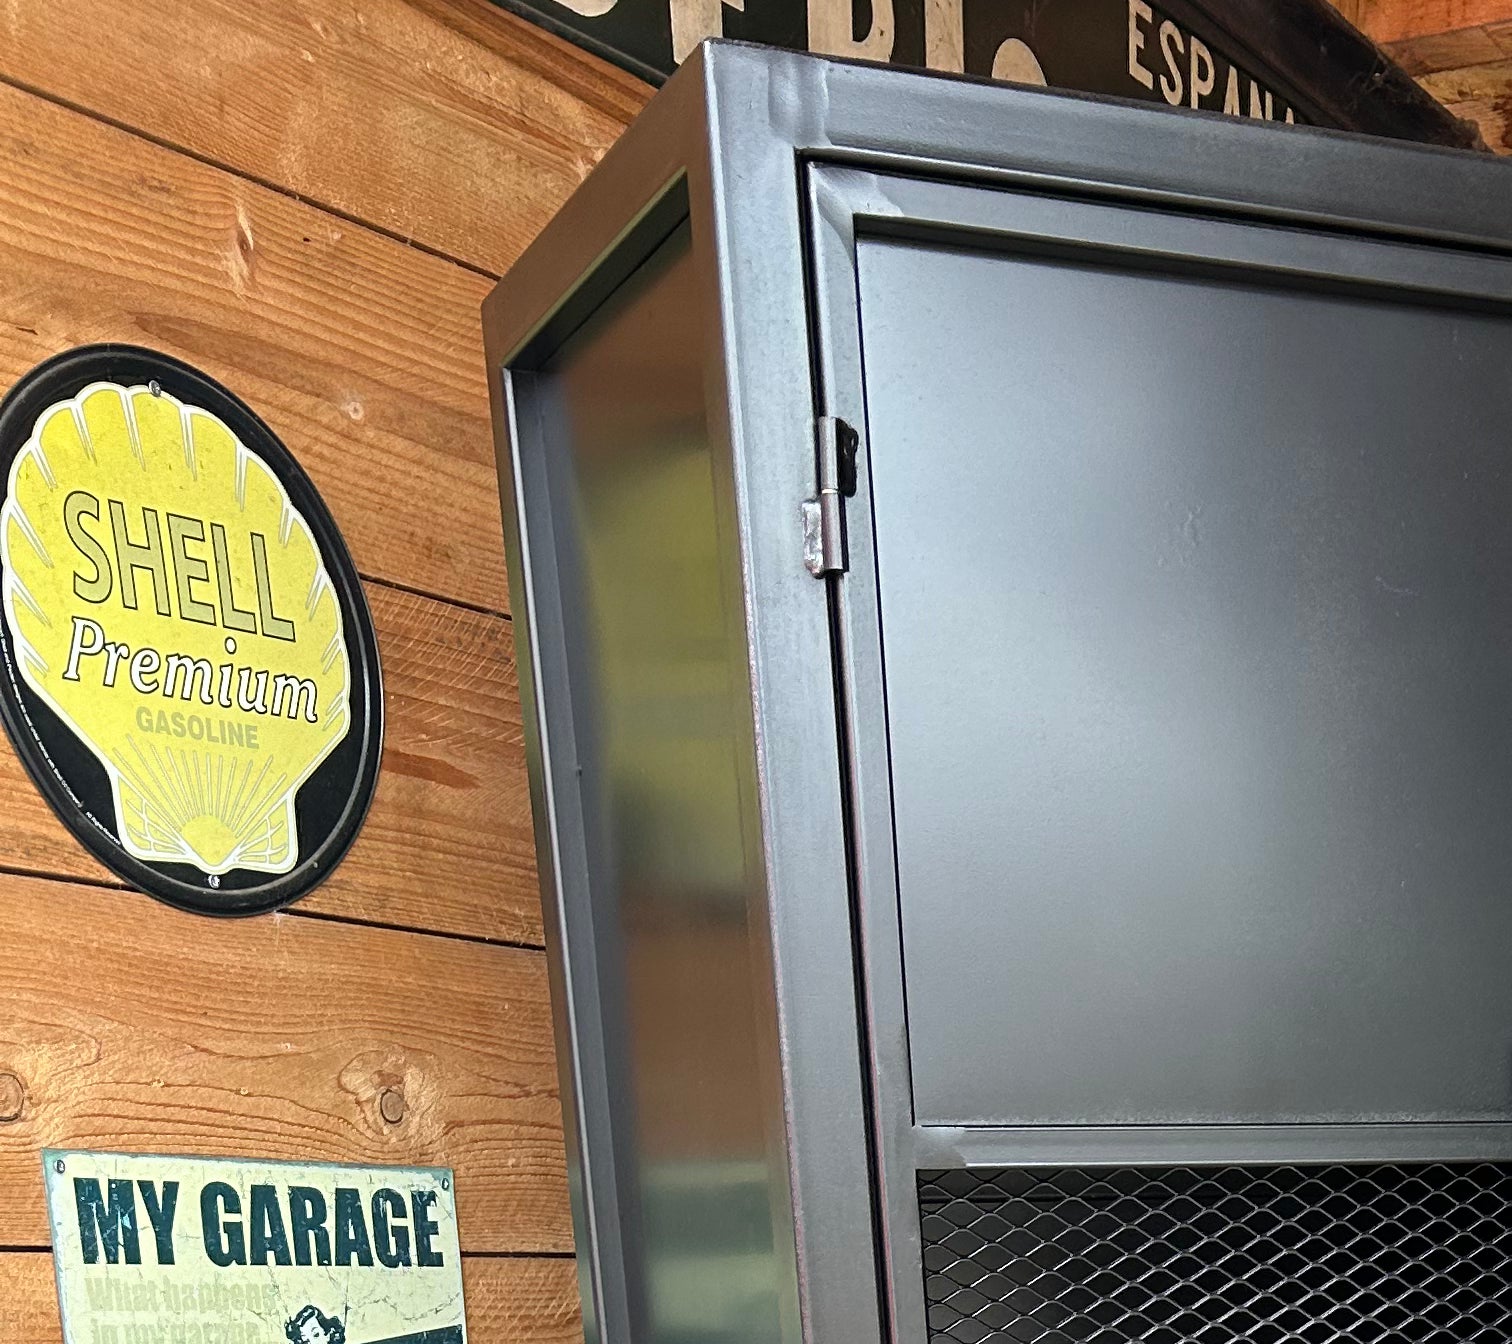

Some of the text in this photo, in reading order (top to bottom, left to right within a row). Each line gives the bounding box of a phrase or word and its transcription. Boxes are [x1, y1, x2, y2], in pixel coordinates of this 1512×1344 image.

[62, 490, 295, 642] SHELL
[62, 616, 318, 723] Premium
[136, 706, 260, 750] GASOLINE
[73, 1177, 444, 1268] MY GARAGE
